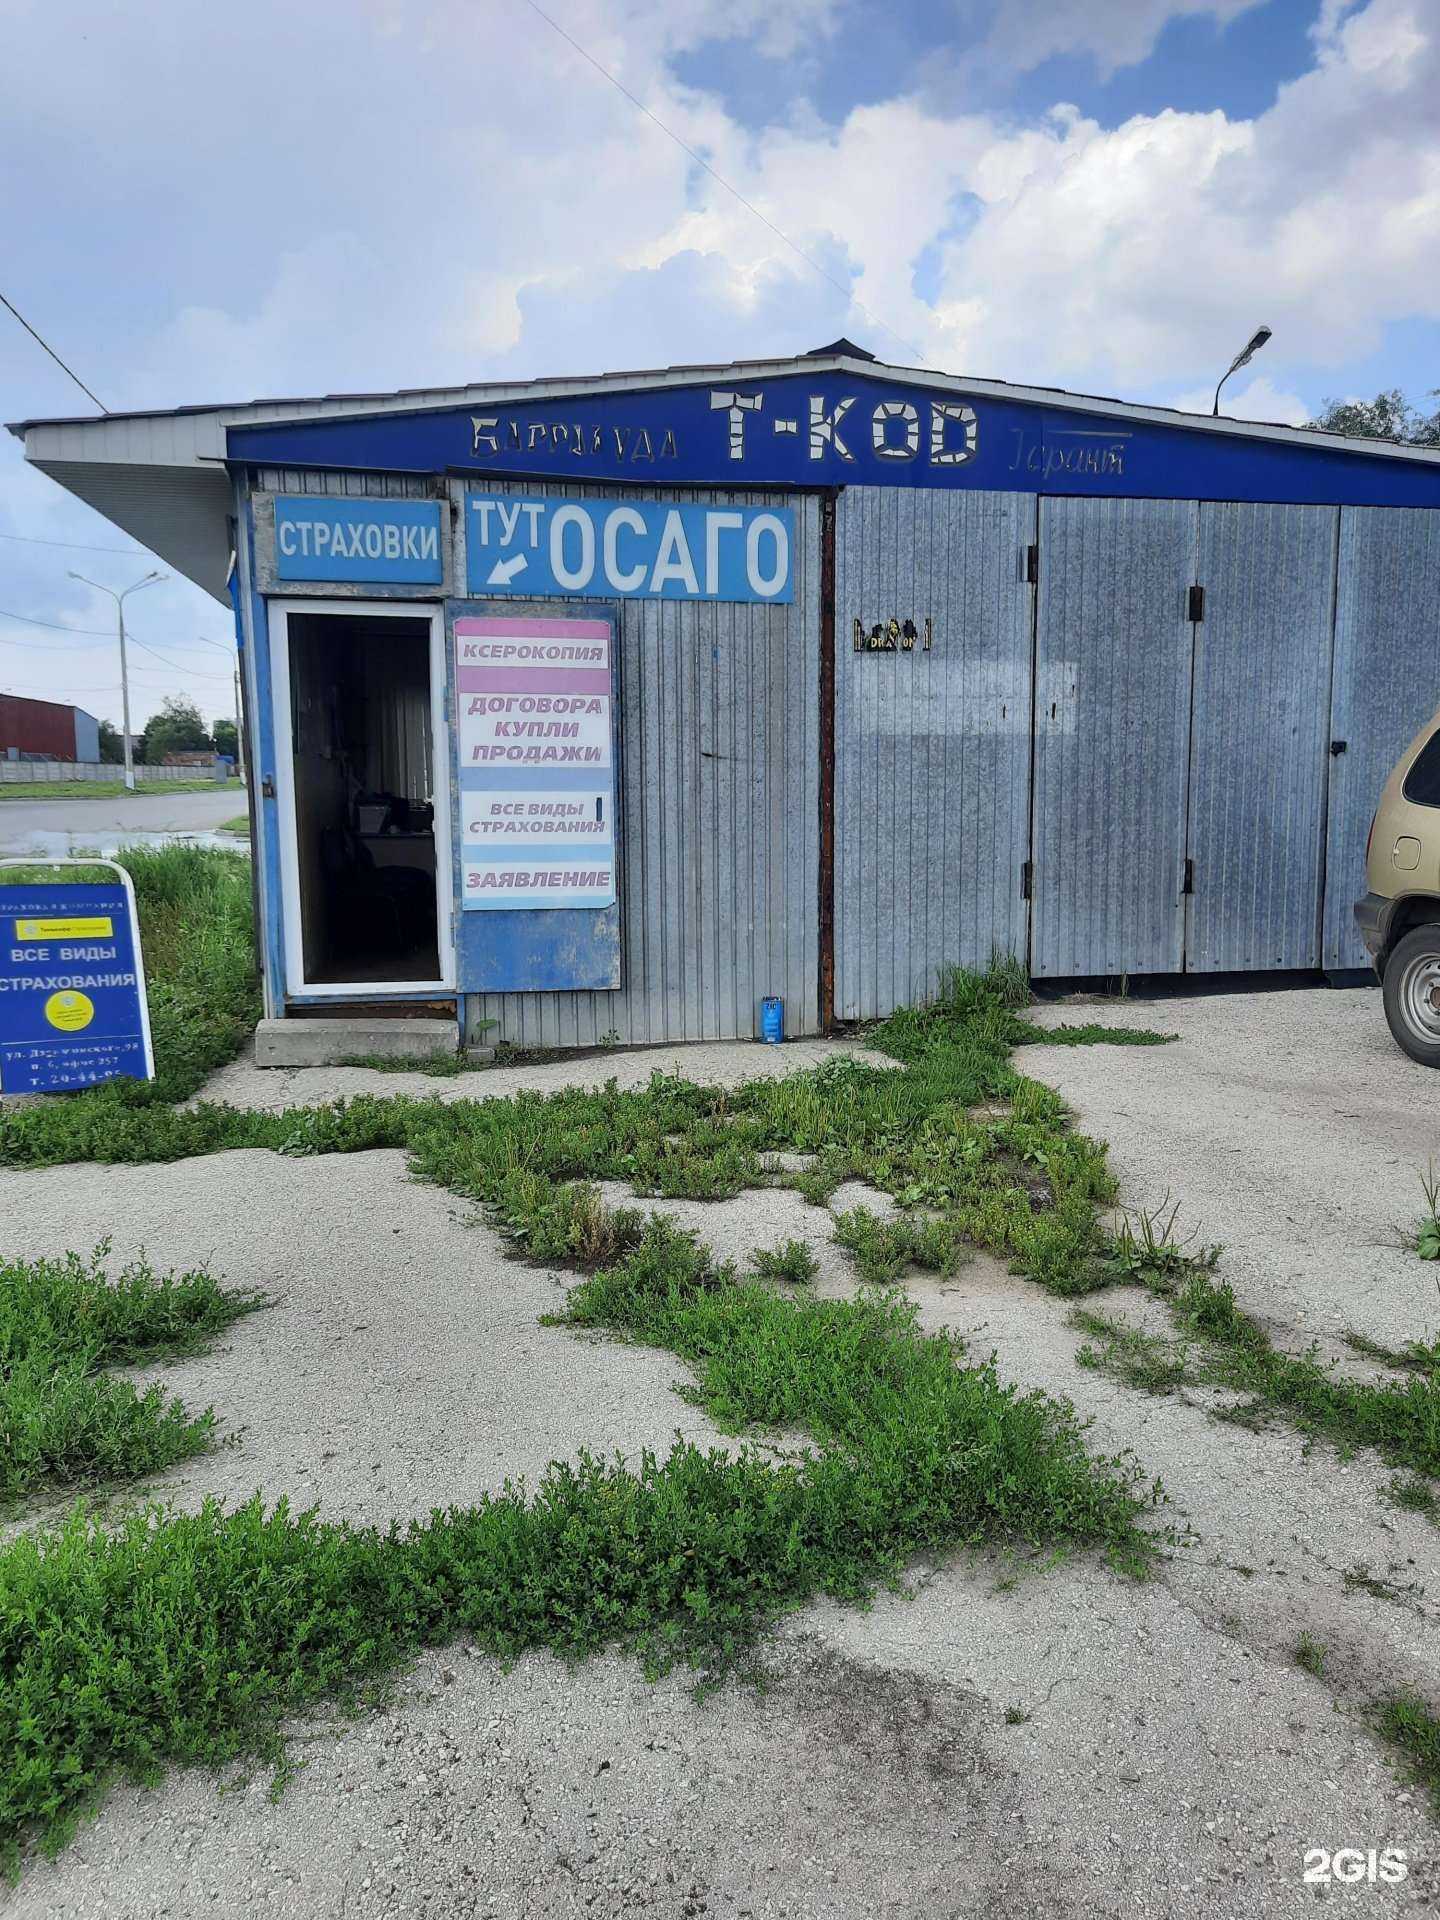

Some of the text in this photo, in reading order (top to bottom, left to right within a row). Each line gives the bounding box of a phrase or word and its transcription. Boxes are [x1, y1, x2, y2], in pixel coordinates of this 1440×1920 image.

[279, 520, 439, 560] СТРАХОВКИ
[472, 501, 789, 597] ТУТ ОСАГО
[463, 644, 604, 661] КСЕРОКОПИЯ
[467, 697, 602, 715] ДОГОВОРА
[494, 722, 580, 738] КУПЛИ
[472, 745, 602, 763] ПРОДАЖИ
[491, 803, 584, 818] ВСЕ ВИДЫ
[469, 820, 606, 834] СТРАХОВАНИЯ
[466, 871, 610, 889] ЗАЯВЛЕНИЕ
[11, 946, 117, 962] ВСЕ ВИДЫ
[0, 973, 137, 991] СТРАХОВАНИЯ
